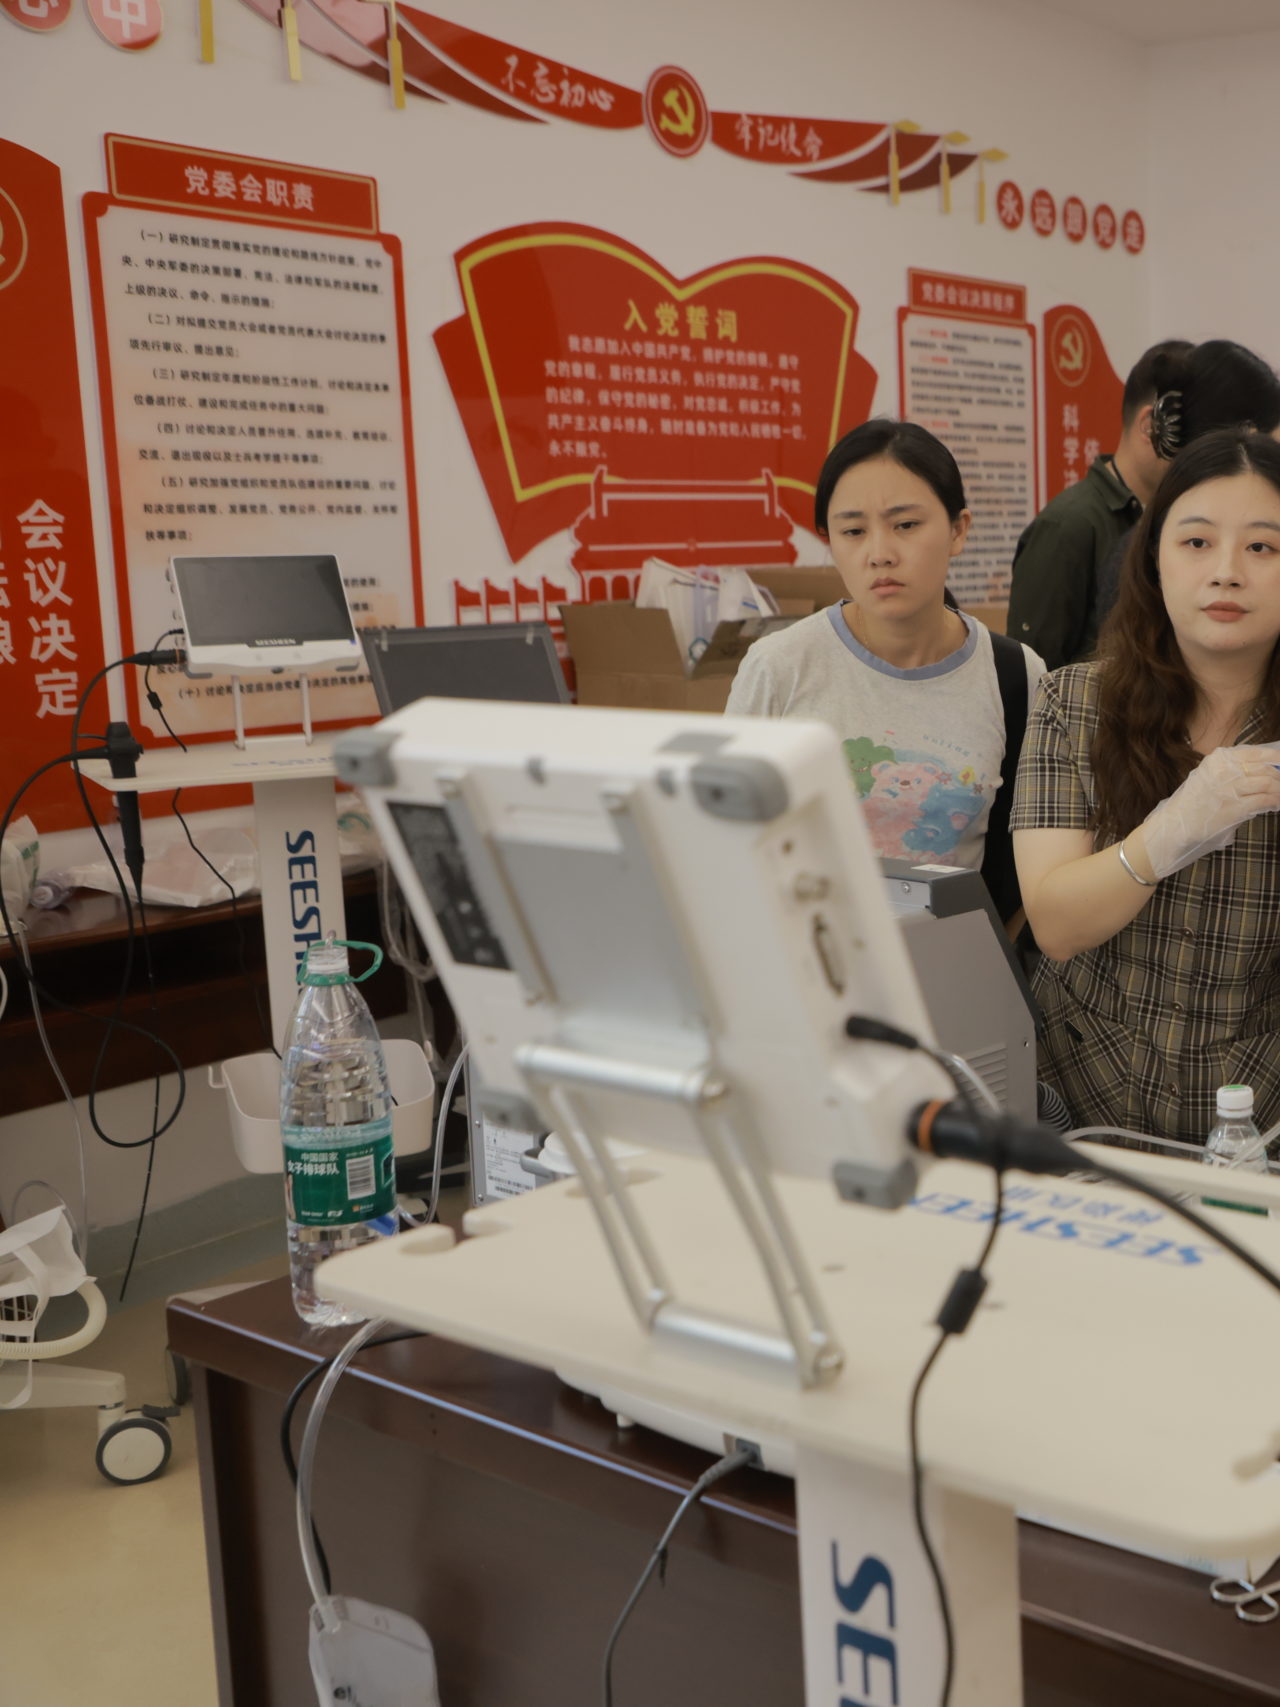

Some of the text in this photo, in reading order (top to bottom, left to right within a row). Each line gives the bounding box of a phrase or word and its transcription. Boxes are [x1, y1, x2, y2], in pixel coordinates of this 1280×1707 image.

[501, 54, 615, 111] 不忘初心
[735, 114, 823, 161] 牢记使命
[184, 165, 315, 212] 党委会职责
[623, 299, 739, 342] 入党誓词
[16, 499, 78, 719] 会议决定
[831, 1538, 899, 1707] SE
